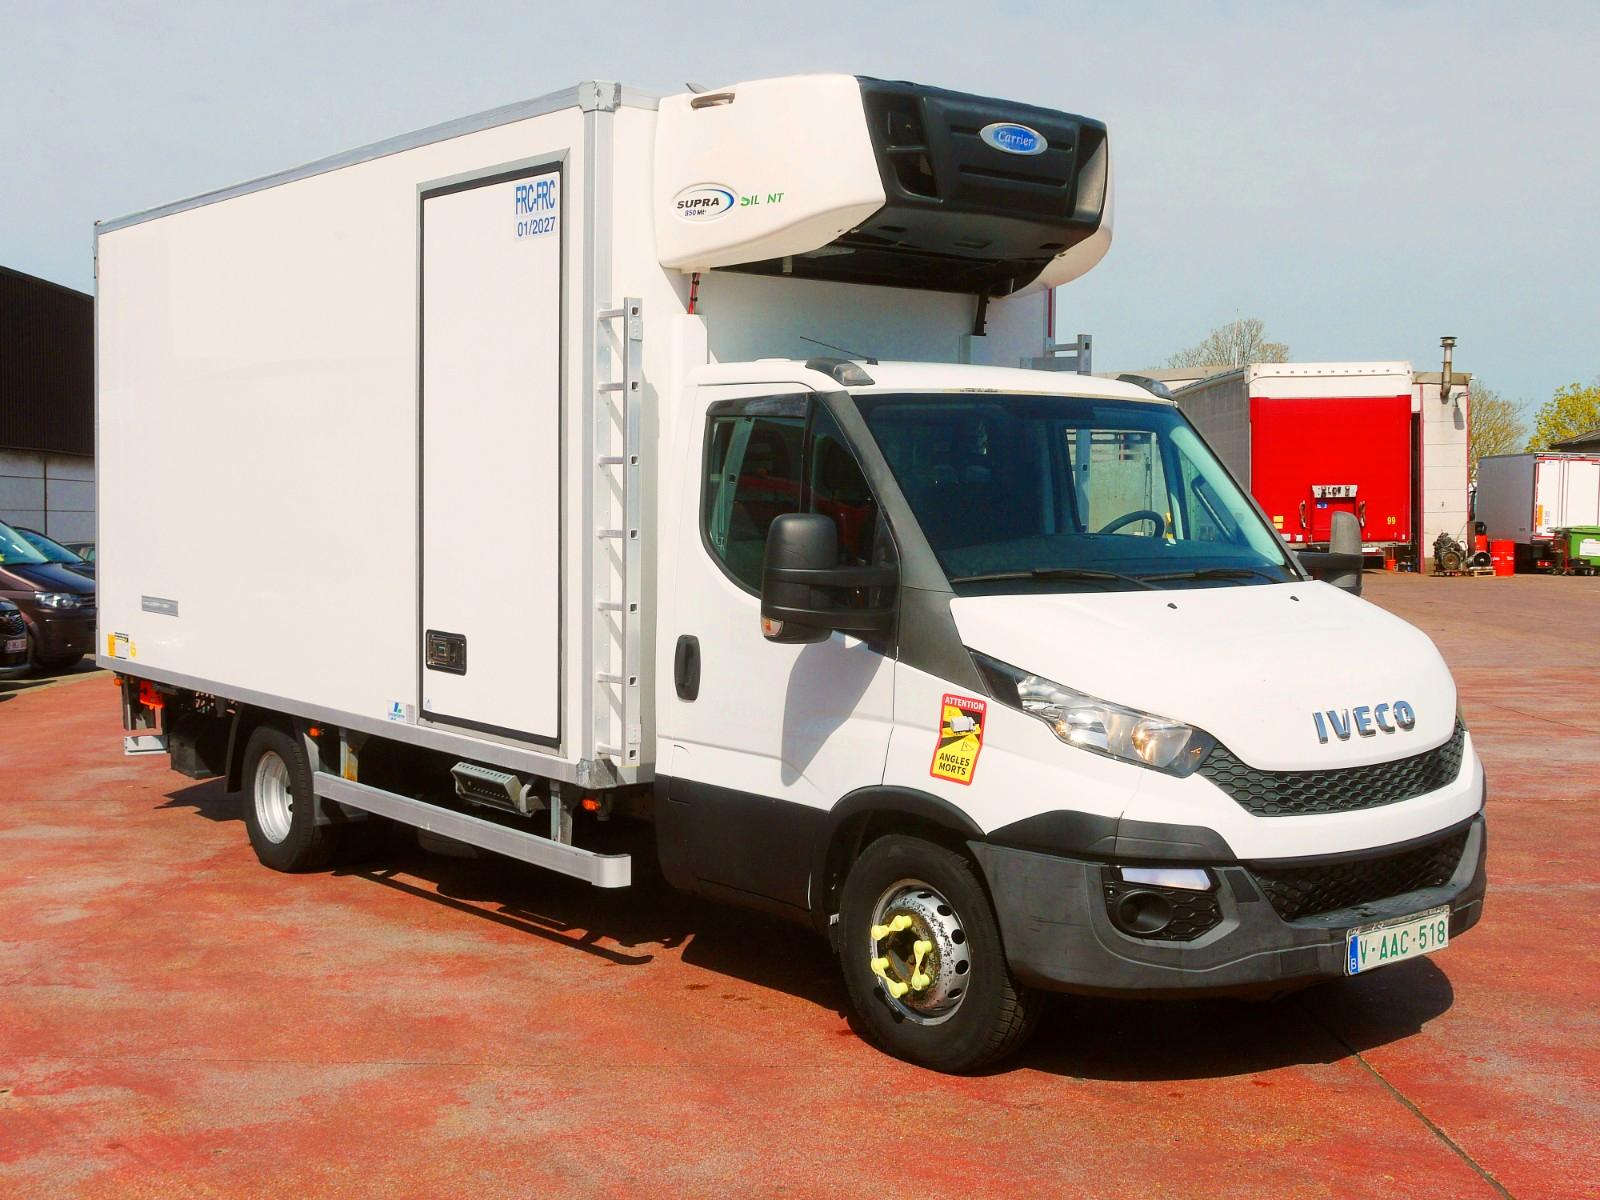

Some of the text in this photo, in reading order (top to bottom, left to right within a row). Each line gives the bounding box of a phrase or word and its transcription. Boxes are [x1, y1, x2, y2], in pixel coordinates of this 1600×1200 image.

[999, 131, 1034, 146] Carrier
[515, 179, 556, 215] FRC-FRC
[677, 198, 720, 209] SUPRA
[517, 216, 556, 237] 01/2027
[944, 696, 984, 710] ATTENTION
[1312, 700, 1416, 744] IVECO
[939, 752, 970, 767] ANGLES
[938, 762, 966, 775] MORTS
[1350, 958, 1357, 970] B
